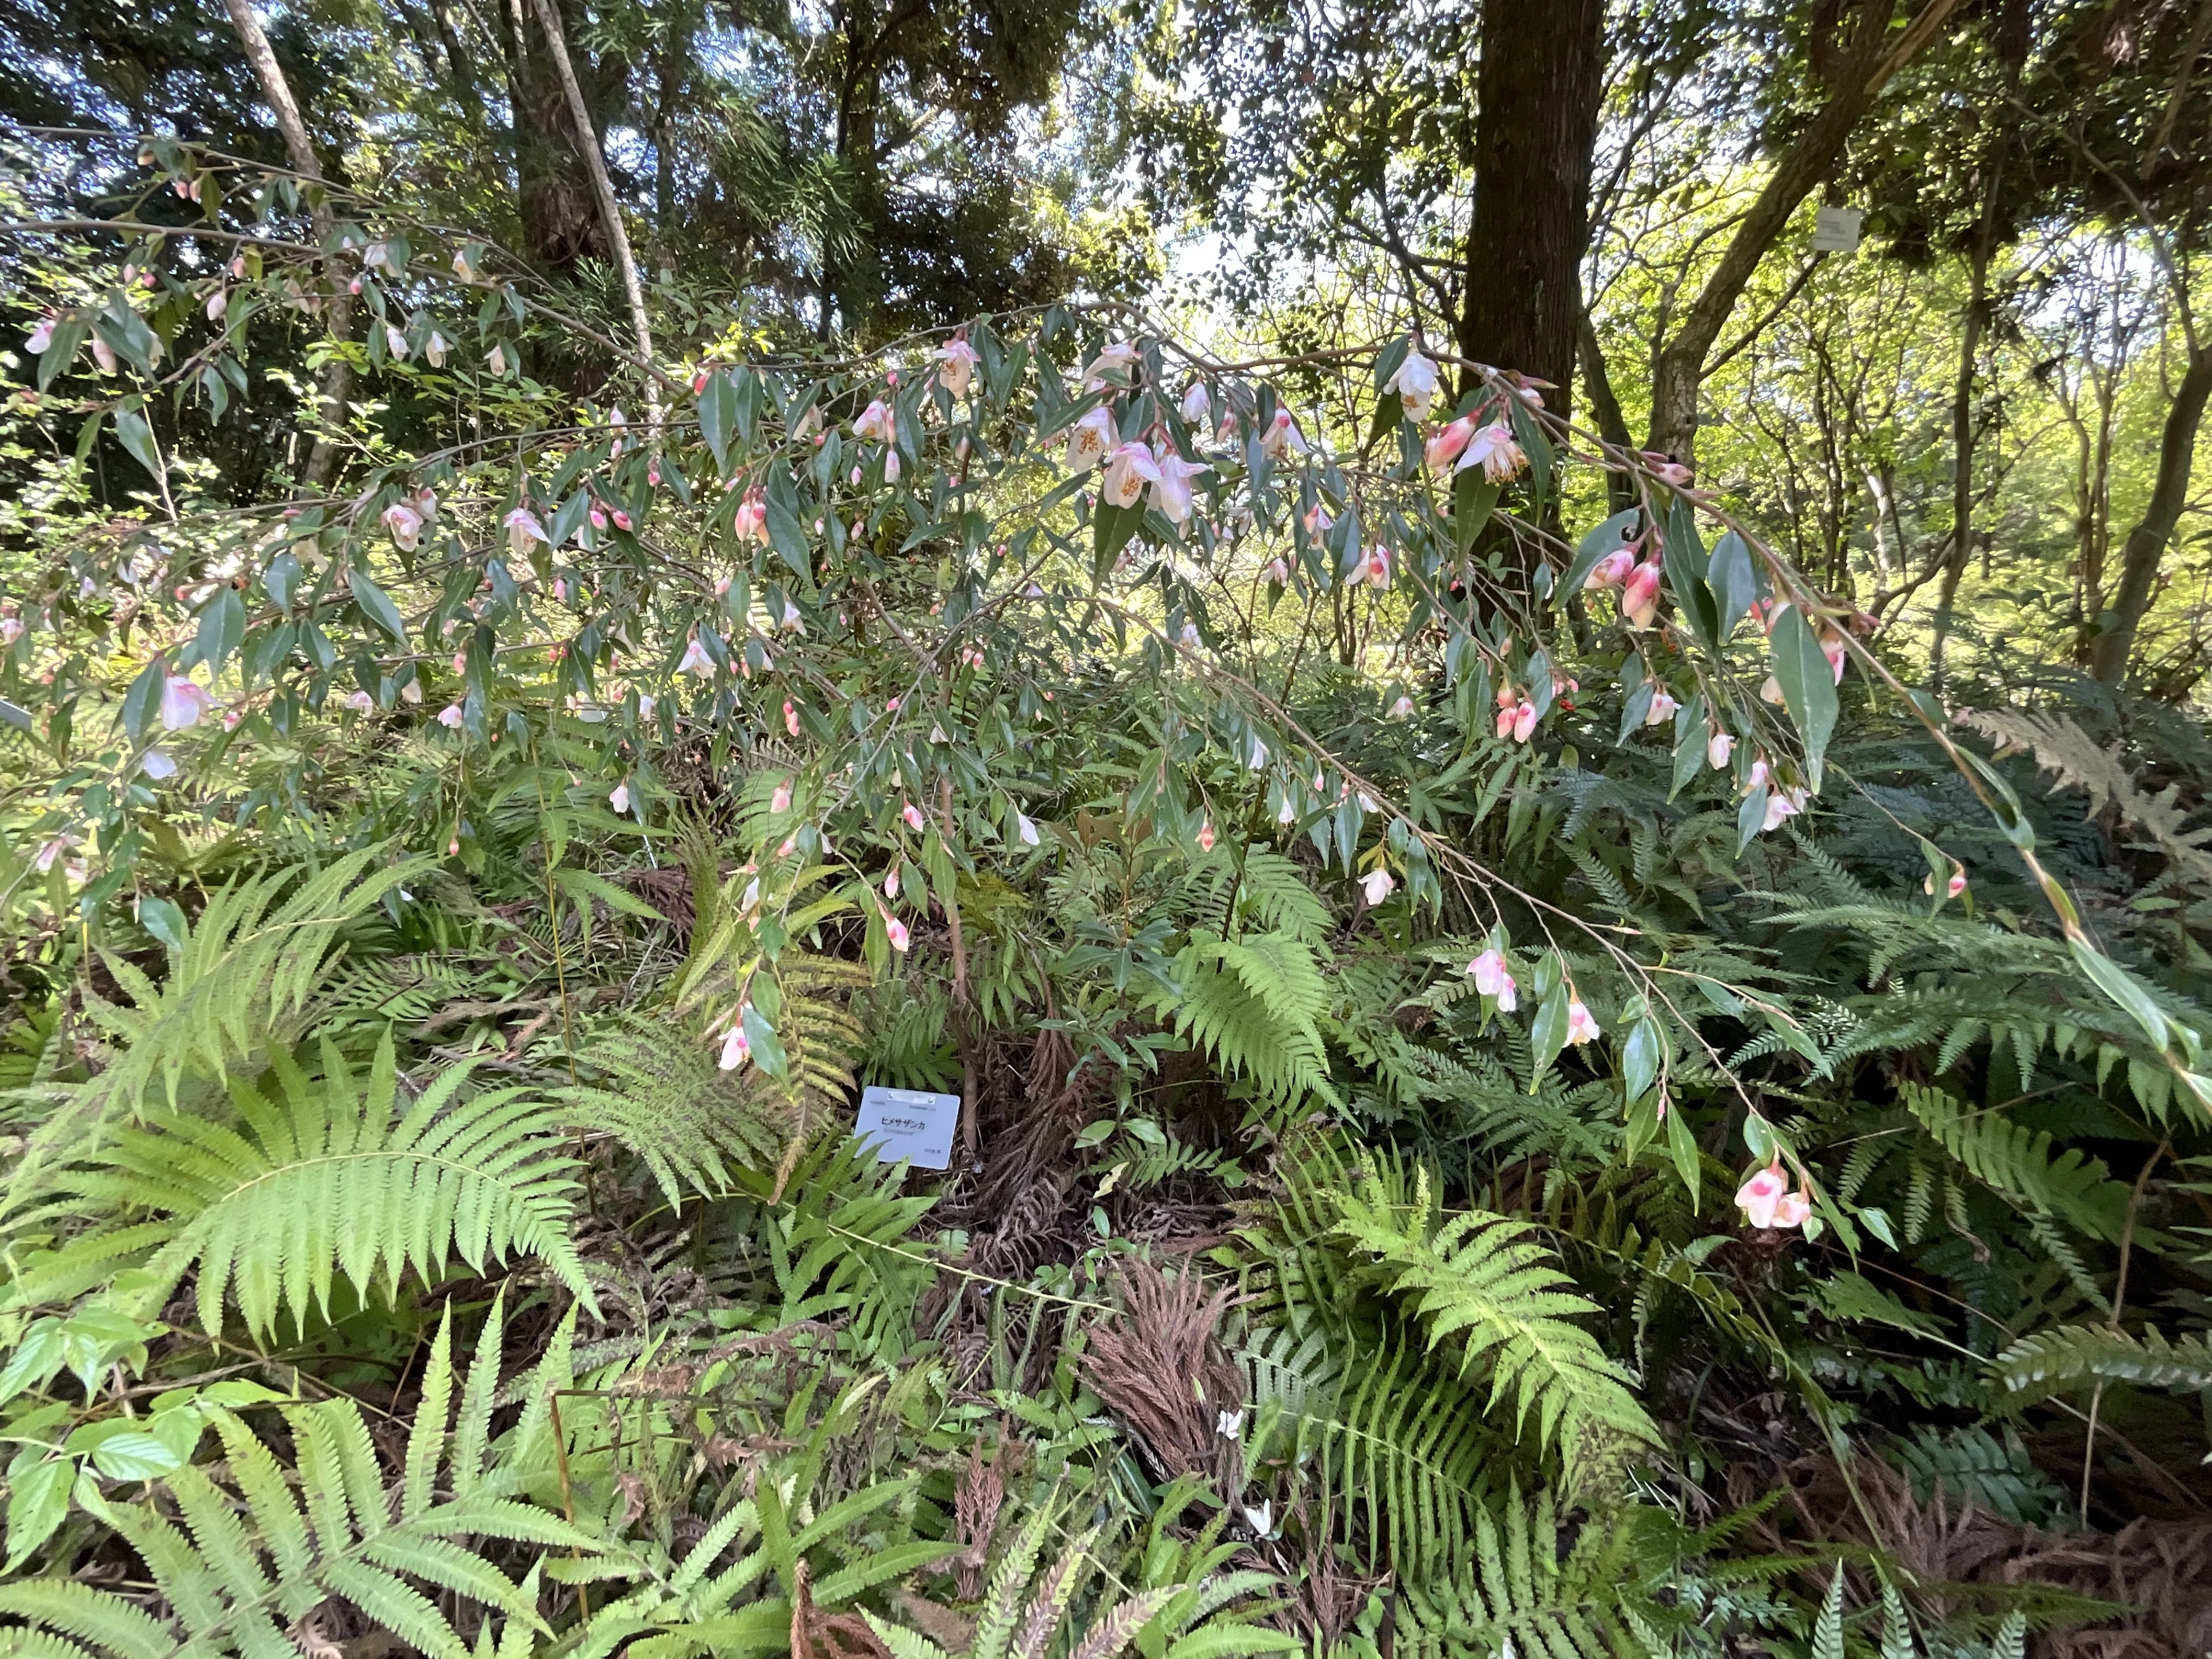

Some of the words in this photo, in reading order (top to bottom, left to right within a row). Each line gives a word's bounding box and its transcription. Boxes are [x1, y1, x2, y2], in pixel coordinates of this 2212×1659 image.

[881, 1117, 926, 1130] ヒメサザンカ
